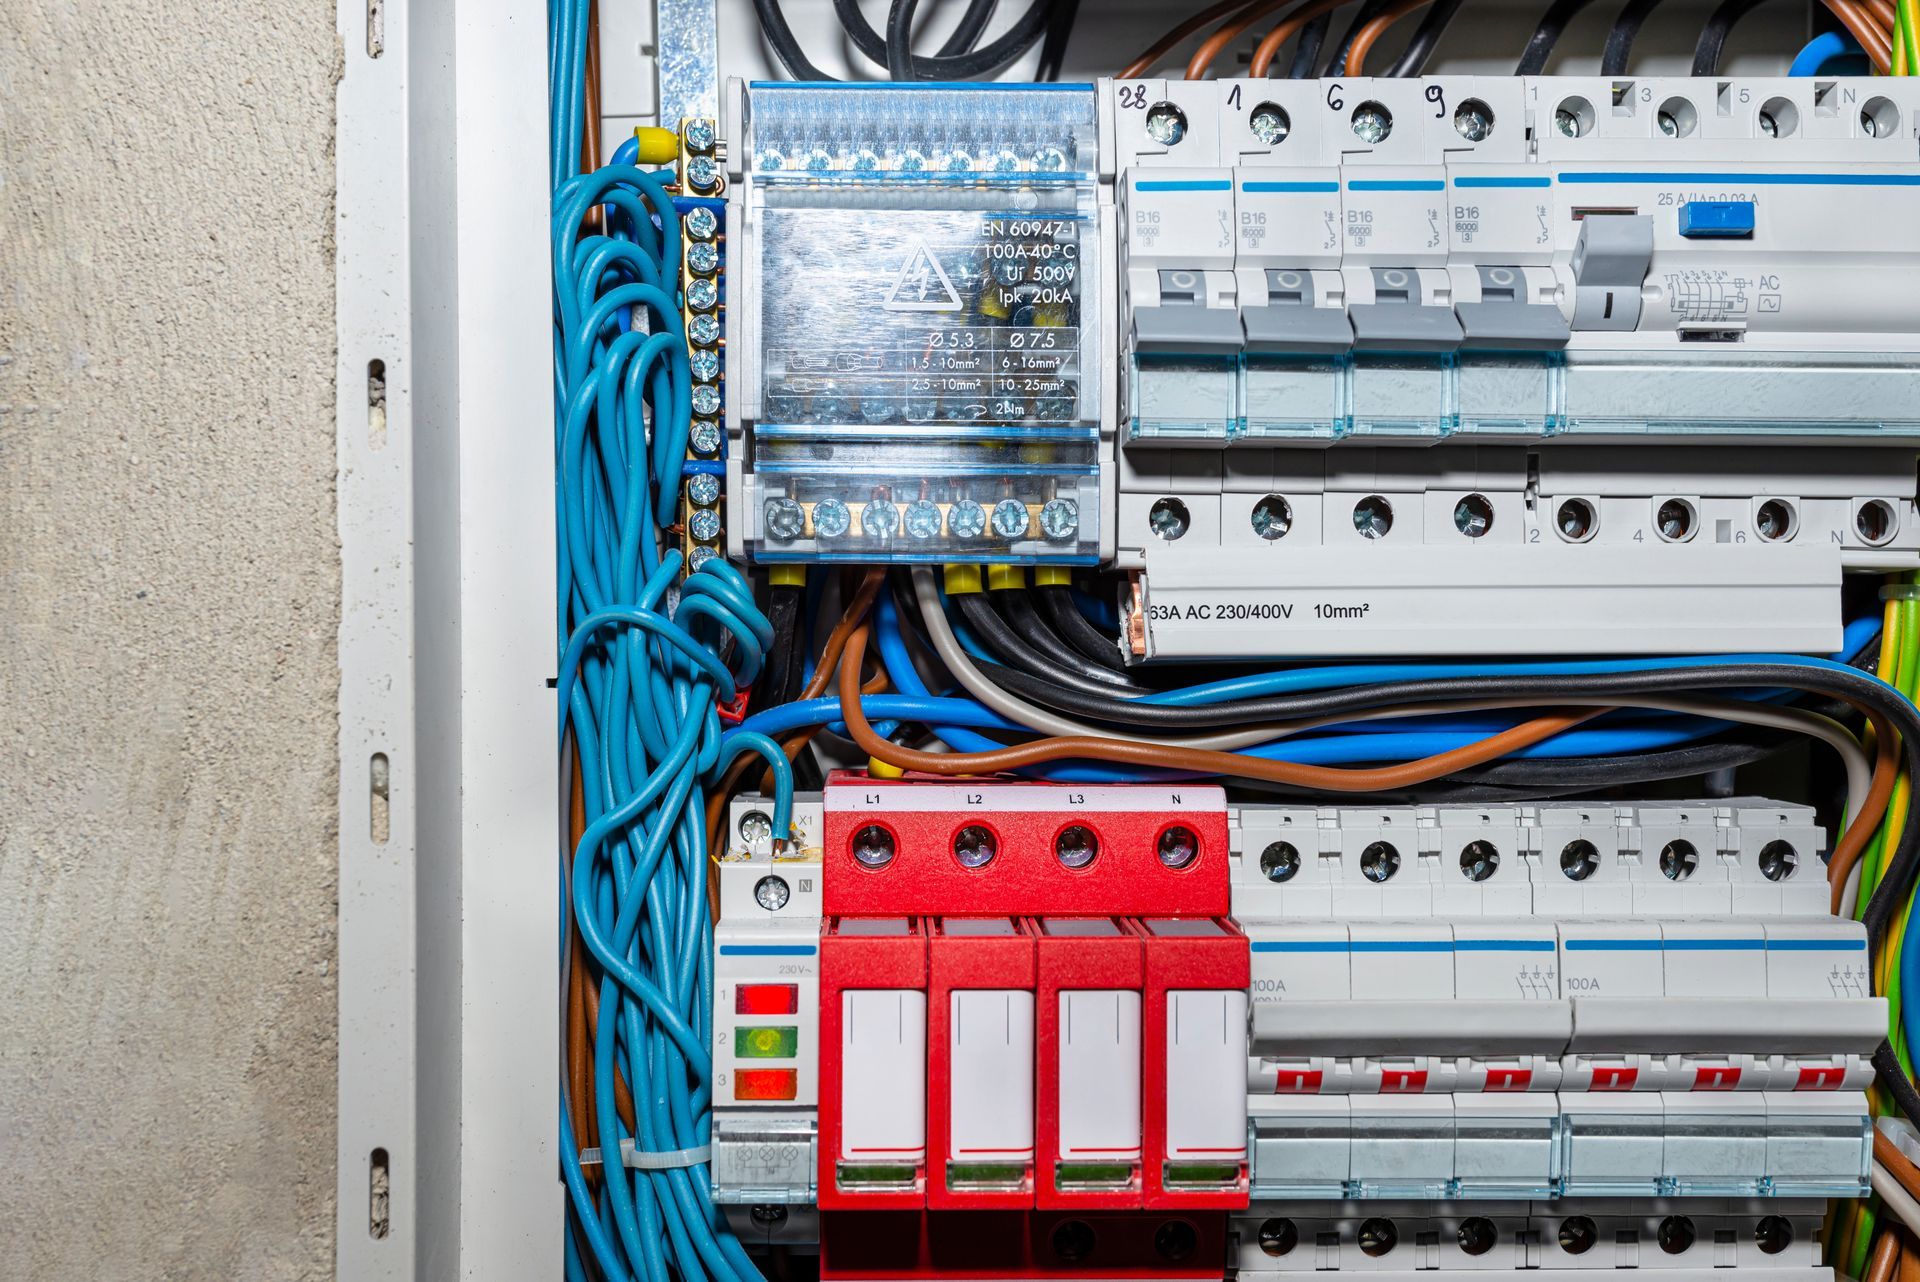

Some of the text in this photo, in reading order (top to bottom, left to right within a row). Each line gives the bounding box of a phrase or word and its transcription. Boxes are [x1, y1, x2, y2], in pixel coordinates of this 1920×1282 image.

[1119, 84, 1147, 110] 28
[1227, 84, 1242, 111] 1
[1326, 84, 1344, 111] 6
[1531, 86, 1538, 101] 1
[1641, 88, 1652, 102] 3
[1739, 89, 1750, 103] 5
[1844, 88, 1856, 103] N
[1425, 85, 1446, 118] 9
[1657, 193, 1674, 206] 25
[1136, 211, 1160, 224] B16
[1241, 212, 1267, 225] B16
[1348, 210, 1373, 223] B16
[1455, 207, 1480, 219] B16
[982, 221, 1075, 237] EN 60947-1
[1456, 222, 1478, 232] 6000
[1033, 266, 1076, 282] 500V
[1759, 275, 1780, 290] AC
[1032, 288, 1074, 304] 20kA
[949, 332, 975, 348] 5.3
[1030, 333, 1055, 348] 7.5
[912, 357, 930, 369] 1.5
[1002, 357, 1010, 368] 6
[911, 379, 931, 391] 2.5
[1000, 379, 1016, 391] 10
[996, 403, 1025, 416] 2Nm
[1529, 528, 1541, 543] 2
[1633, 529, 1644, 543] 4
[1735, 530, 1746, 543] 6
[1831, 530, 1844, 544] N
[1150, 603, 1370, 620] 63A AC 230/400V 10mm²
[866, 794, 881, 804] L1
[967, 794, 983, 805] L2
[1069, 794, 1085, 805] L3
[1172, 794, 1181, 805] N
[798, 815, 813, 826] X1
[801, 880, 812, 891] N
[1251, 979, 1287, 992] 100A
[1565, 978, 1600, 990] 100A
[720, 989, 726, 1000] 1
[718, 1032, 727, 1044] 2
[718, 1074, 726, 1086] 3
